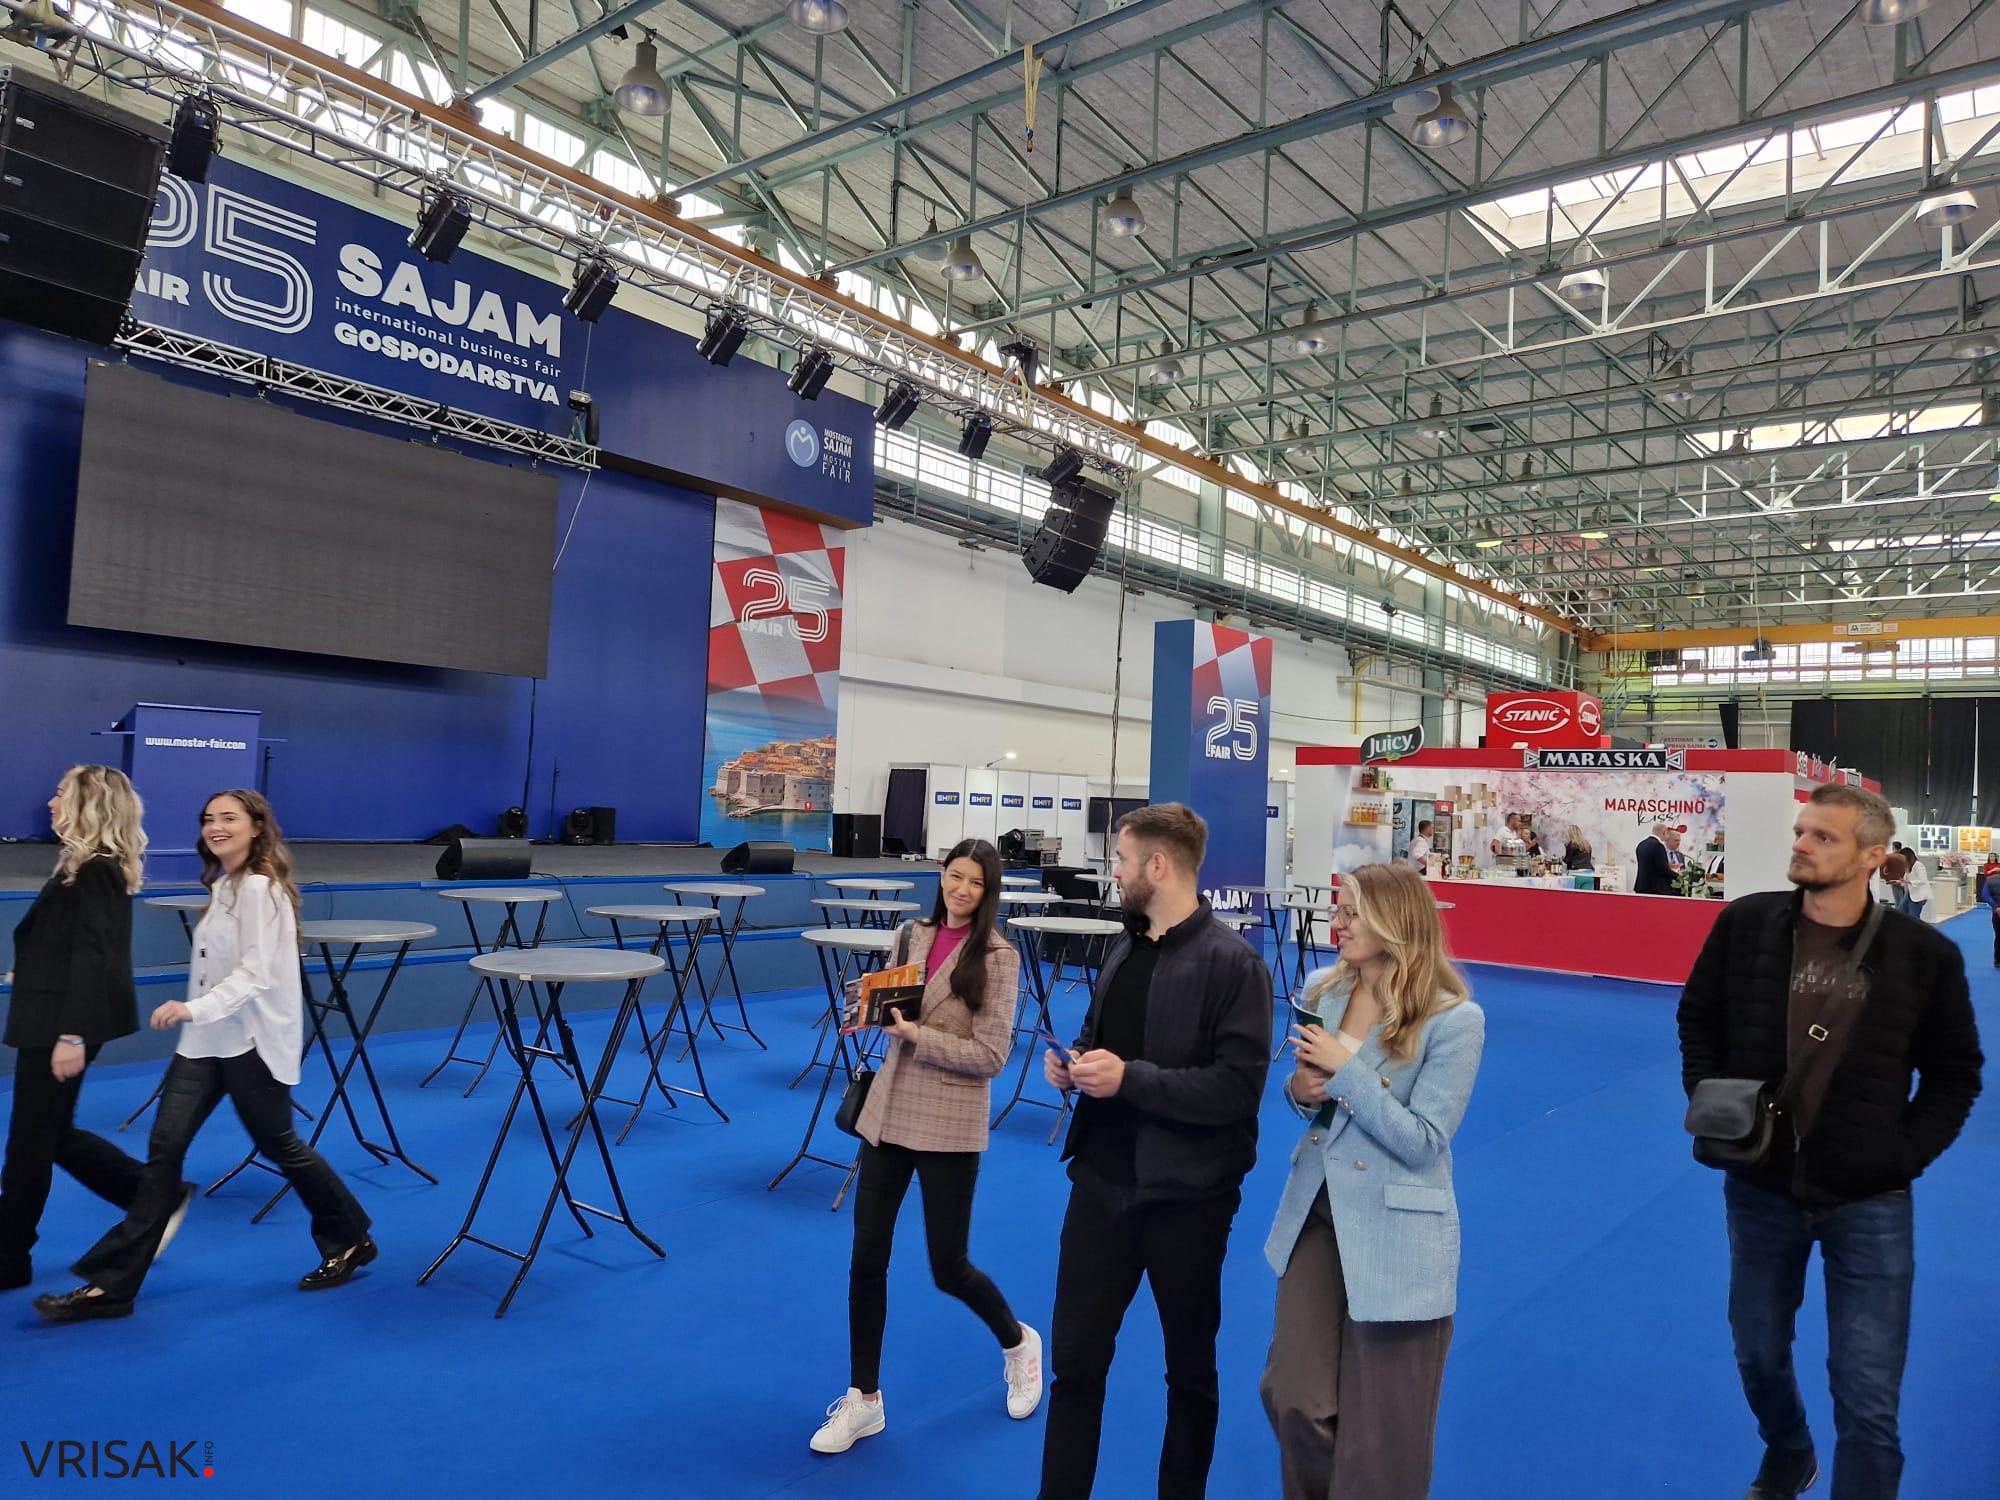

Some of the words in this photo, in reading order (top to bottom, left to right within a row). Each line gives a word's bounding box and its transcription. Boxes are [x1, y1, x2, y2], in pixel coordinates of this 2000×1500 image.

[336, 243, 562, 358] SAJAM
[335, 297, 454, 345] international
[460, 336, 529, 368] business
[534, 360, 561, 378] fair
[333, 321, 561, 406] GOSPODARSTVA
[823, 437, 852, 458] SAJAM
[822, 453, 851, 469] MOSTAR
[822, 462, 851, 484] FAIR
[741, 568, 831, 643] 25
[751, 621, 784, 638] FAIR
[1502, 707, 1562, 722] STANIĆ
[1205, 696, 1259, 761] 25
[145, 737, 247, 750] www.mostar-fair.com
[1209, 744, 1231, 760] FAIR
[1543, 752, 1661, 768] MARASKA
[1604, 797, 1706, 815] MARASCHINO
